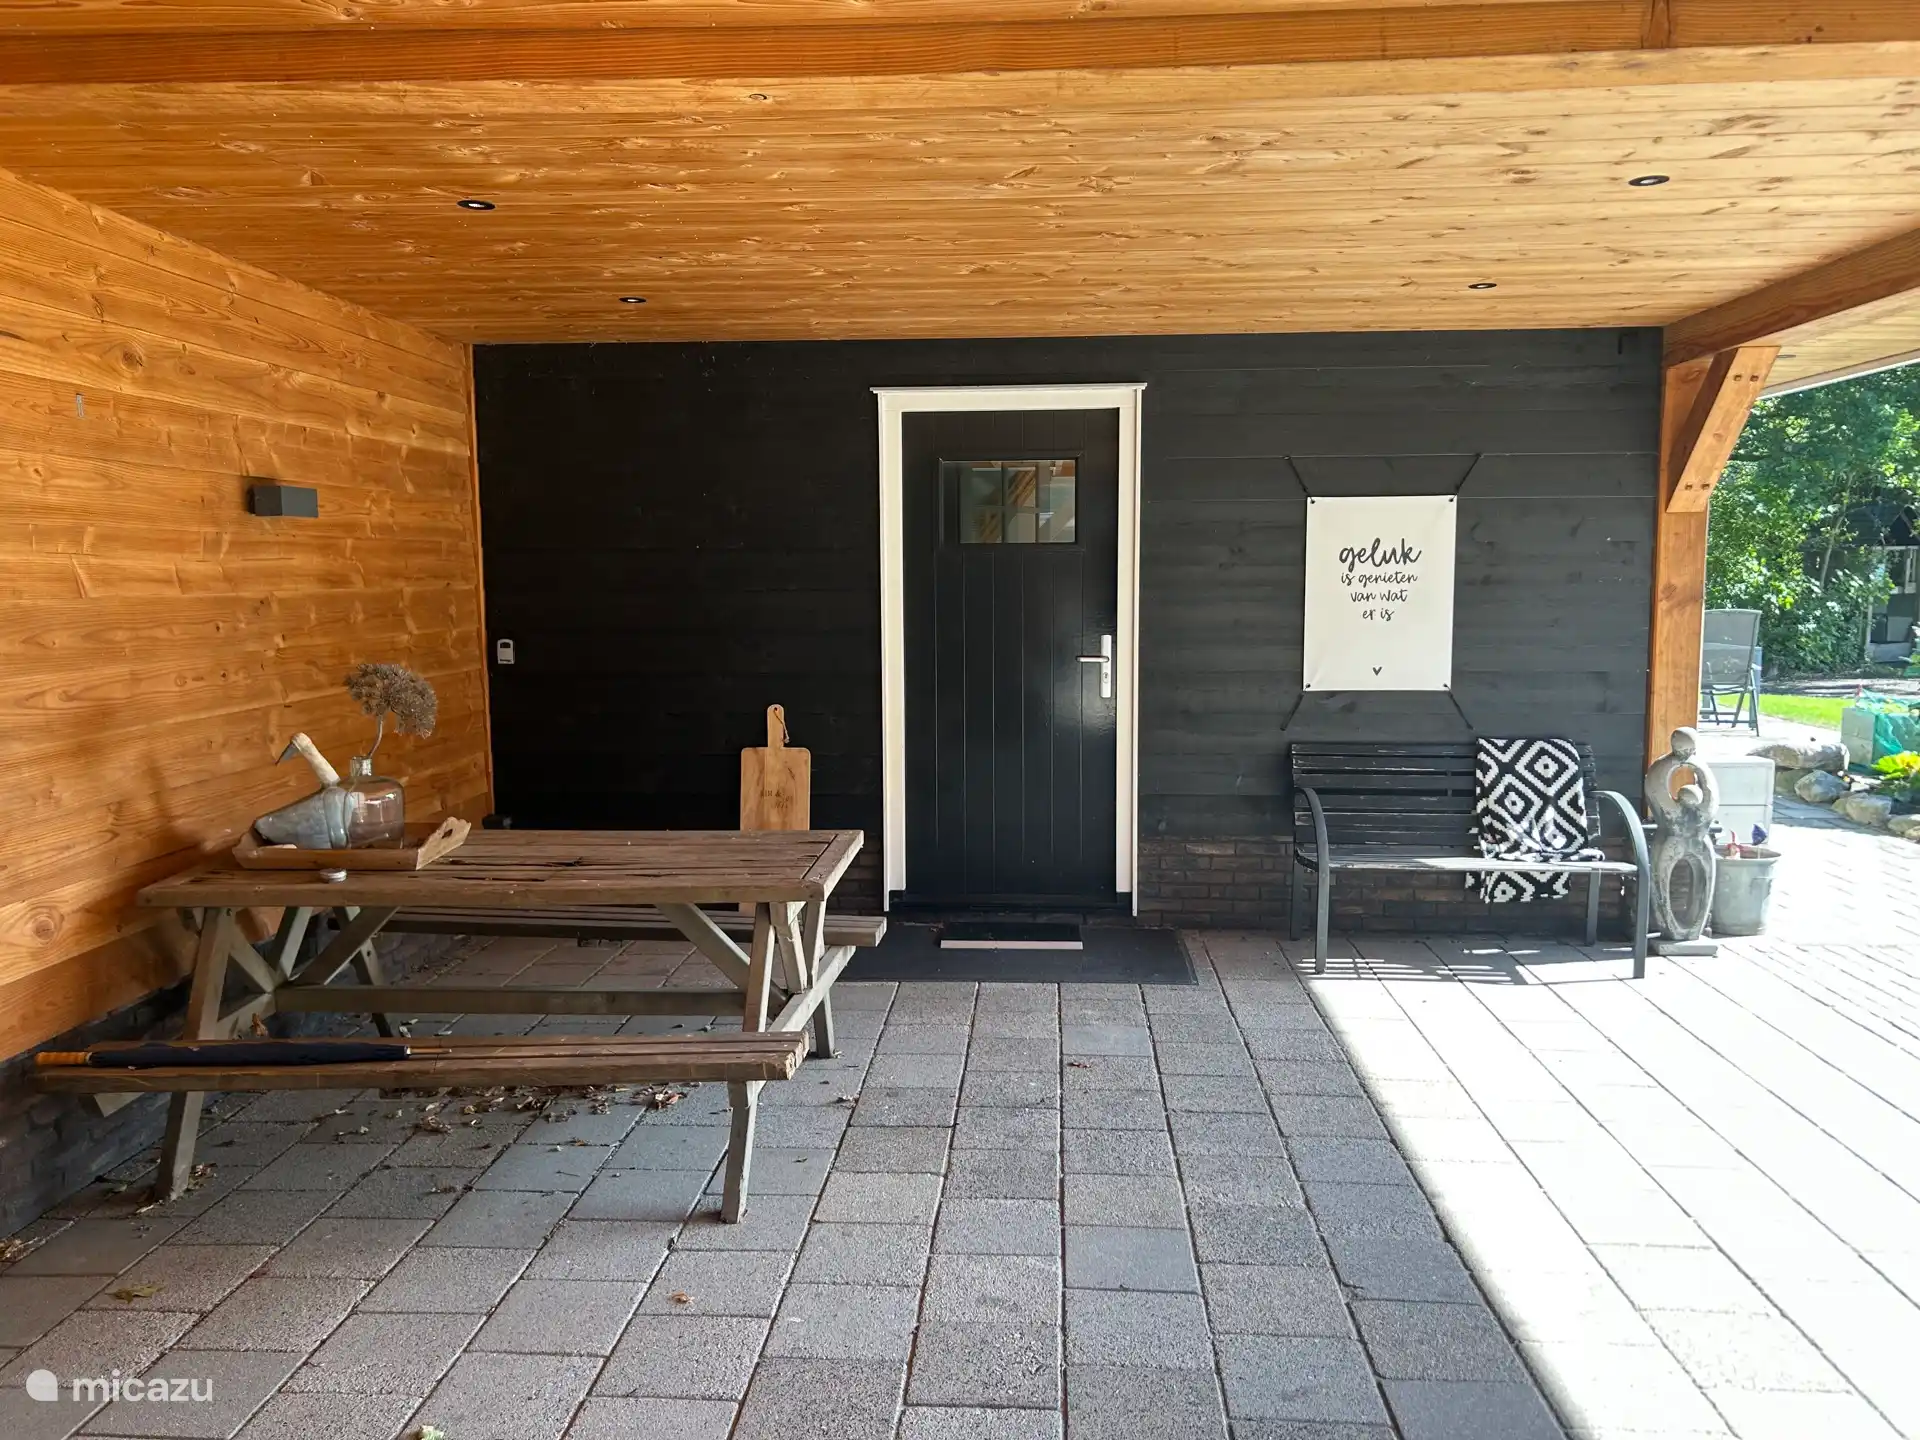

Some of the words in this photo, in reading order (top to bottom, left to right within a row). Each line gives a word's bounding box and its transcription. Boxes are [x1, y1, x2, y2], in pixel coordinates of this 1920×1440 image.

[1338, 537, 1422, 573] geluk
[1341, 572, 1356, 586] is
[1358, 571, 1418, 588] genieten
[1350, 590, 1376, 602] van
[1362, 608, 1376, 620] er
[1380, 607, 1395, 621] is
